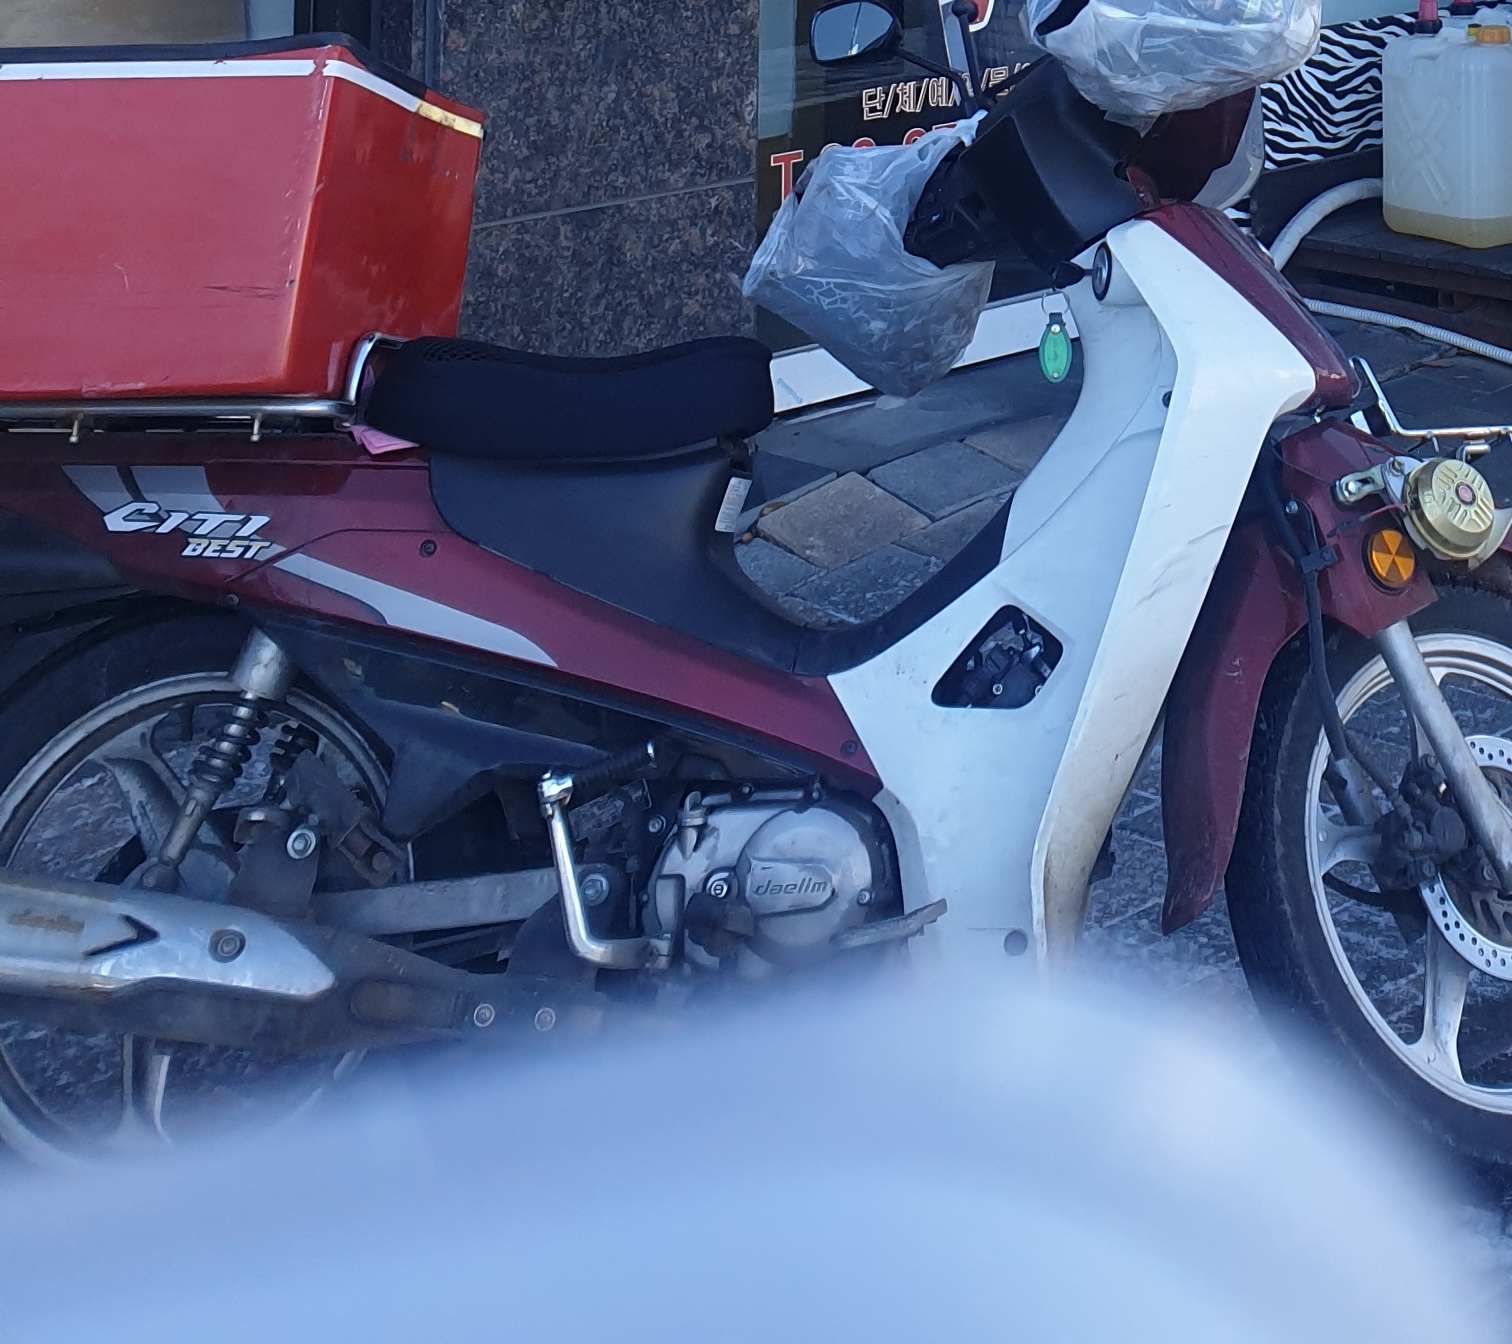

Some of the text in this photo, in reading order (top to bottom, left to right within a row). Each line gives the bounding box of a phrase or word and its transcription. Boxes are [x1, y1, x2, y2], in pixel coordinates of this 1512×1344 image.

[103, 502, 271, 537] CITI
[181, 538, 272, 559] BEST
[754, 877, 828, 896] daelim
